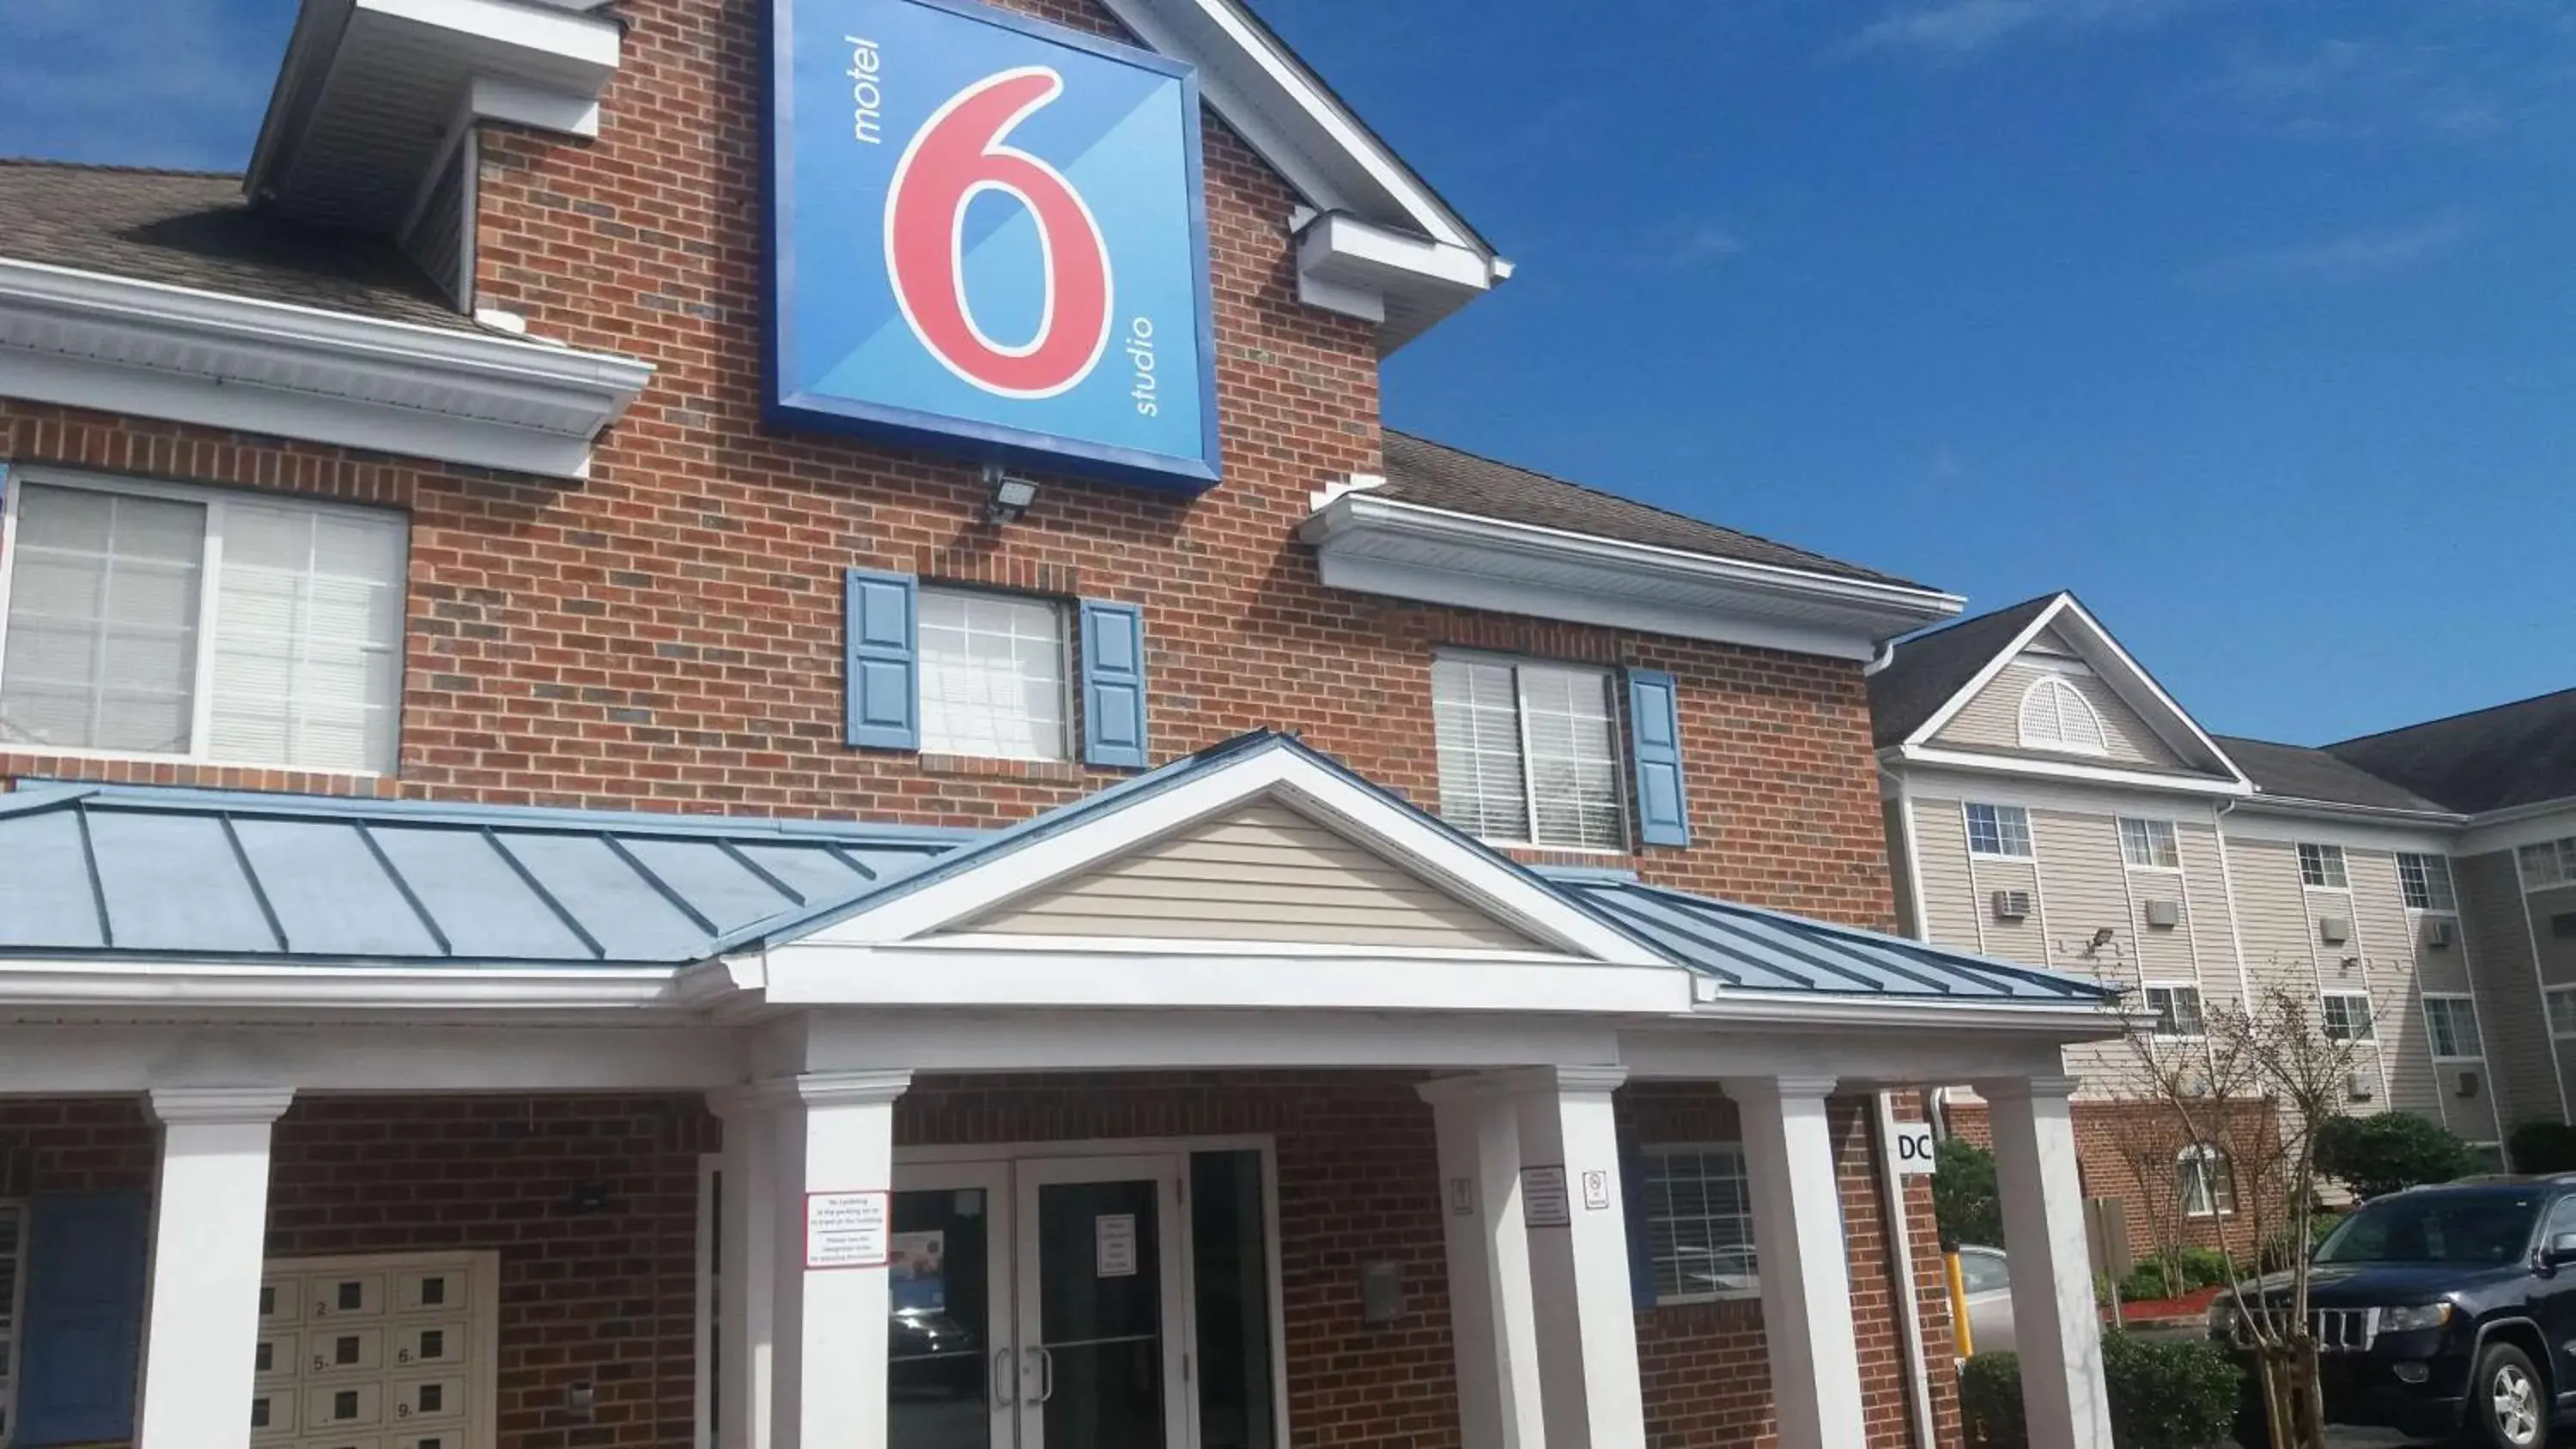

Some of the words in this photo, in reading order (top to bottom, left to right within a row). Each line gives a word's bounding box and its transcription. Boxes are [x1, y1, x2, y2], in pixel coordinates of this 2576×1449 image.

[844, 35, 881, 144] motel
[884, 65, 1114, 399] 6
[1126, 317, 1157, 417] studio
[1898, 1134, 1932, 1160] DC
